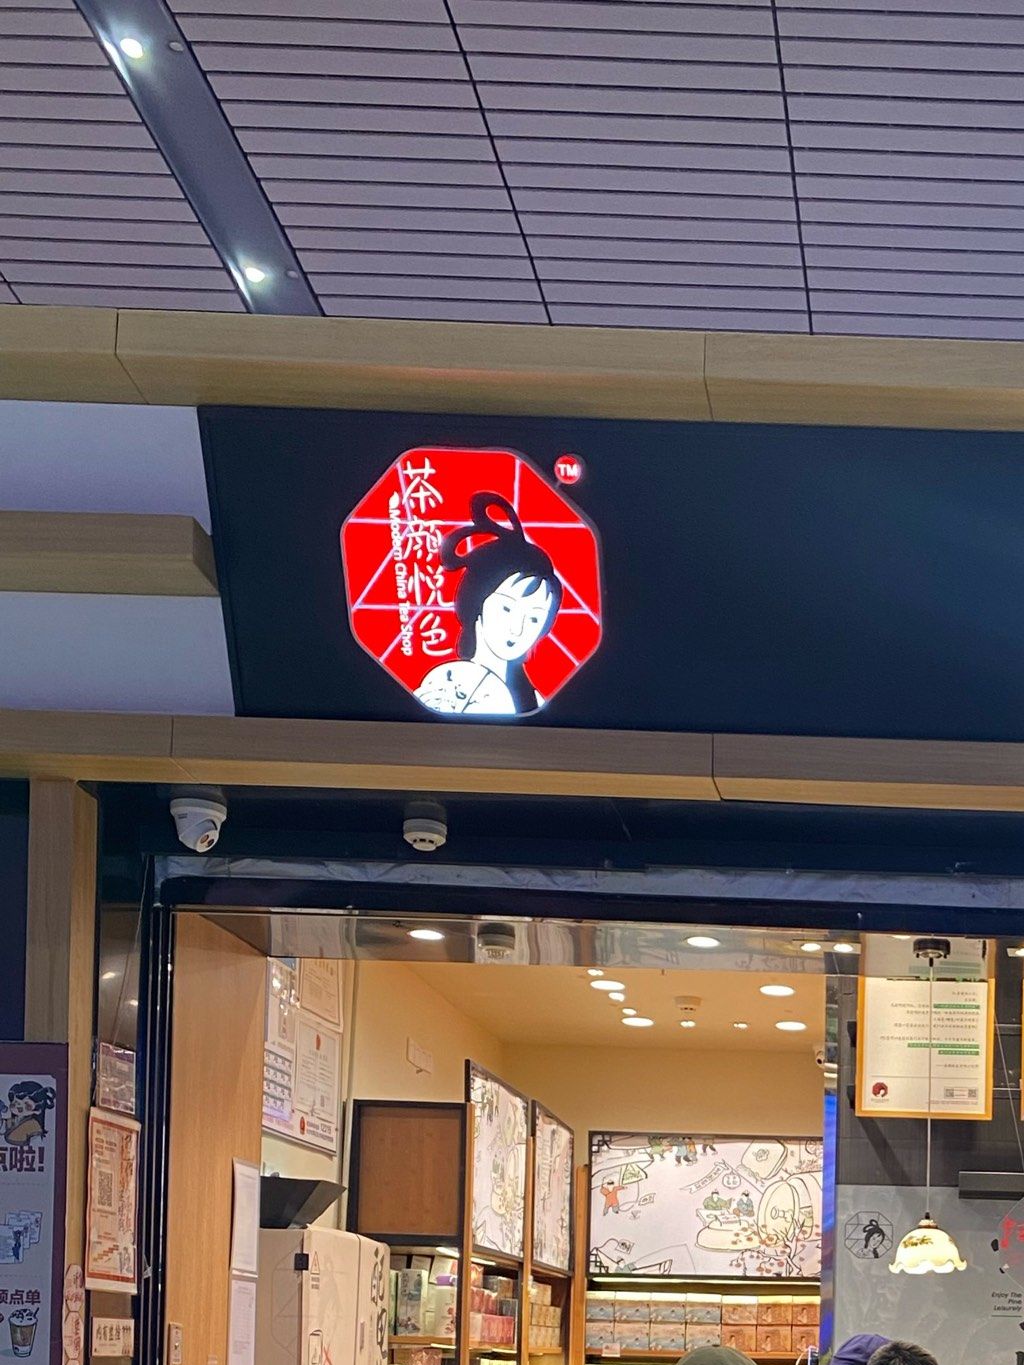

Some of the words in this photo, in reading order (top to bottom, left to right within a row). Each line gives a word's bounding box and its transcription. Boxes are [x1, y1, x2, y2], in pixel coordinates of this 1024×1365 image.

[557, 463, 579, 477] TM
[389, 509, 403, 561] Modern
[394, 562, 407, 600] China
[398, 601, 408, 624] Tea
[400, 624, 414, 657] Shop
